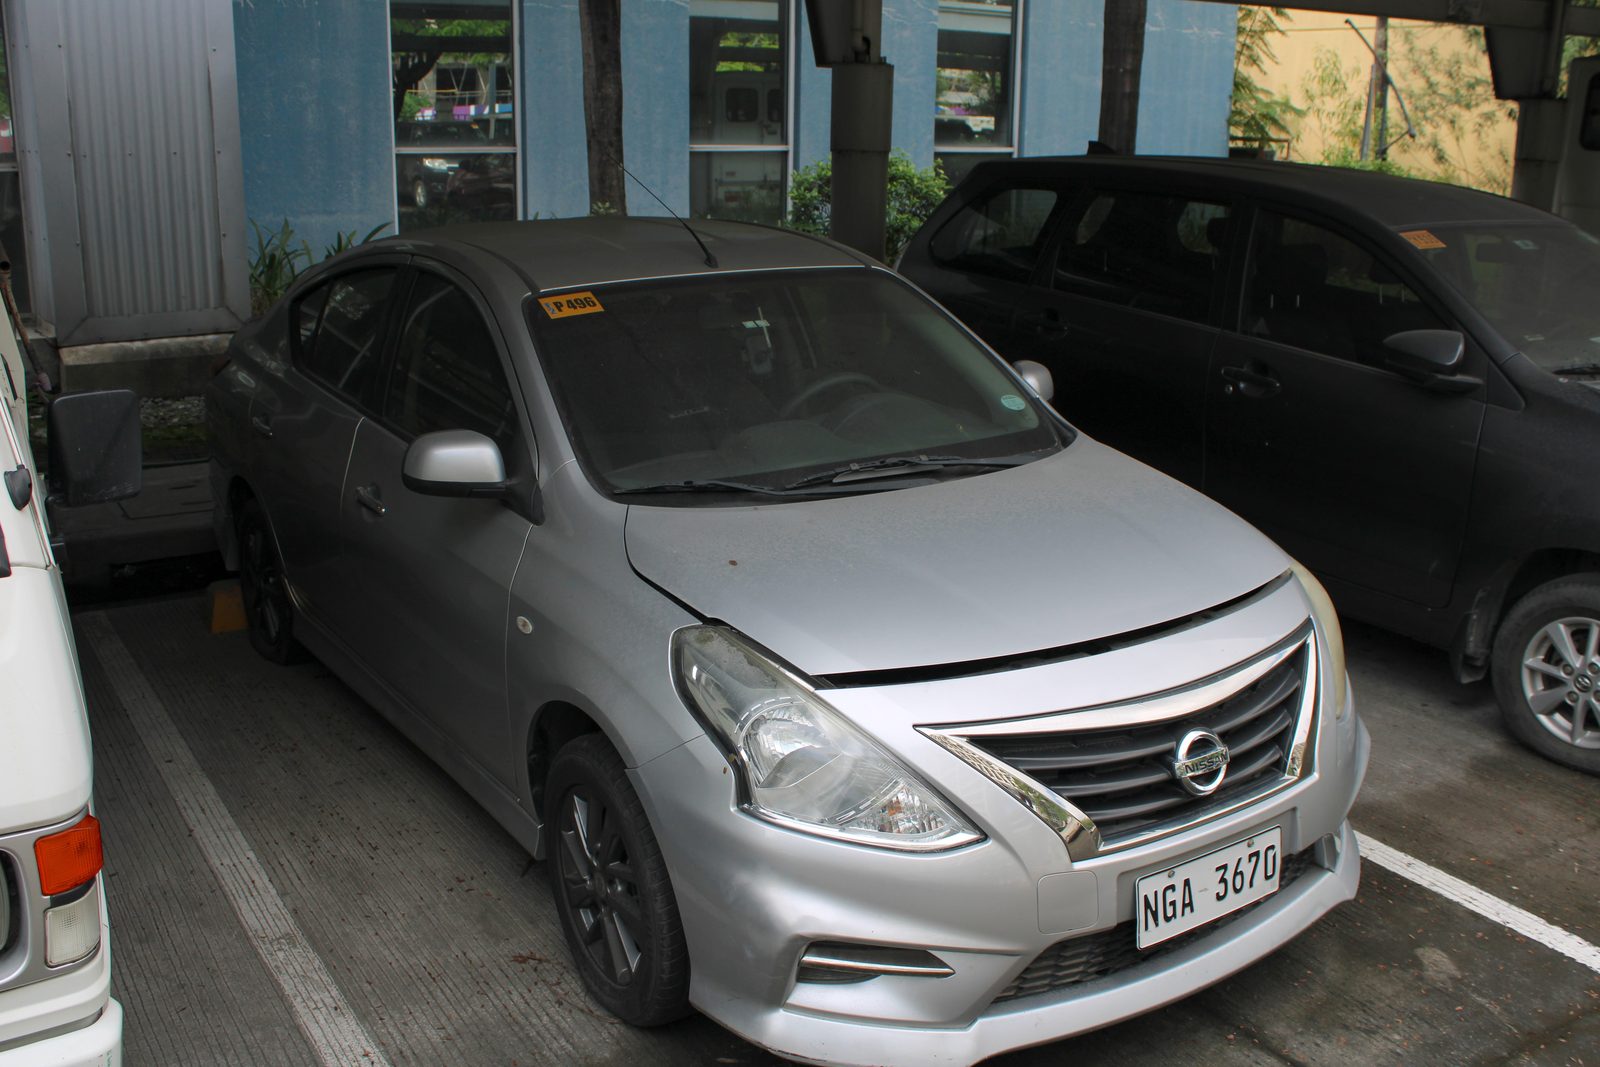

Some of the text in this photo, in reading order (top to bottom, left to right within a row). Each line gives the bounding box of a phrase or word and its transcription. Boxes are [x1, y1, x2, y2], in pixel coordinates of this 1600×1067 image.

[565, 296, 597, 310] 496
[1184, 752, 1227, 774] NISSAN
[1143, 844, 1277, 932] NGA 3670
